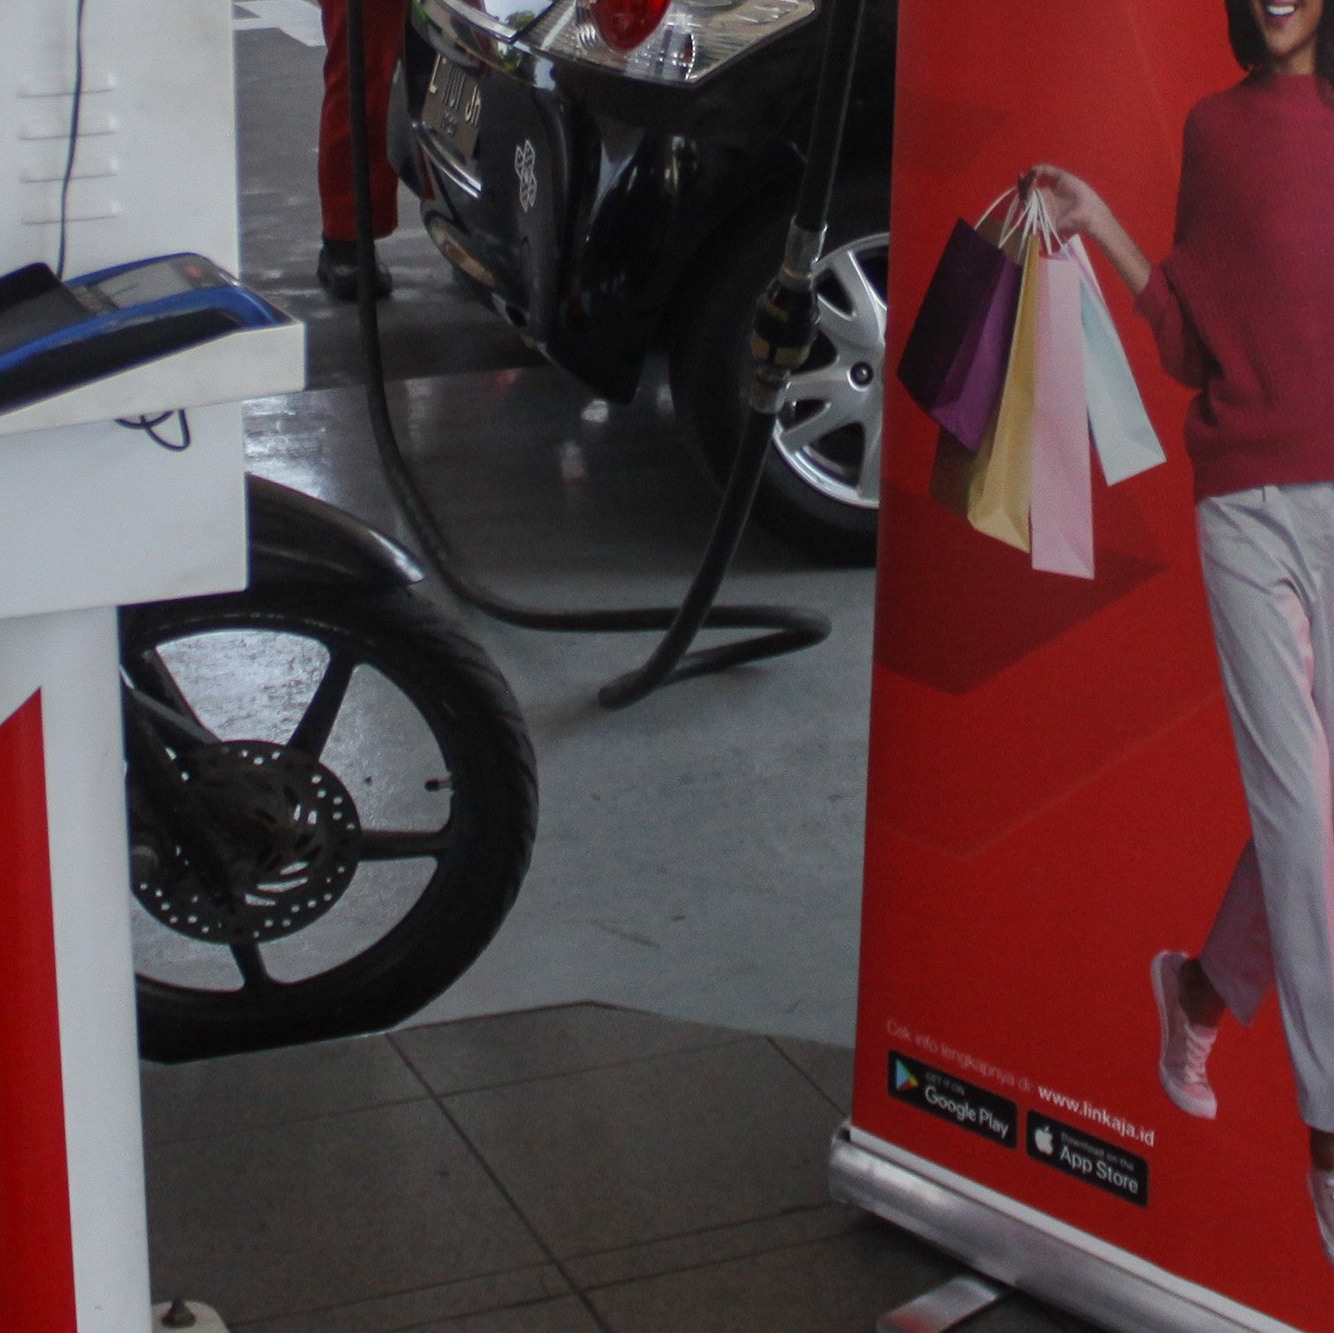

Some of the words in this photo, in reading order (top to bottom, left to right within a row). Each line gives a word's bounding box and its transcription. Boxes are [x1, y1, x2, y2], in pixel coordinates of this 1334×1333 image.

[925, 1084, 977, 1121] Google
[979, 1108, 1009, 1140] Play
[1038, 1085, 1155, 1147] www.linkaja.id
[1059, 1145, 1093, 1174] App
[1095, 1160, 1139, 1194] Store
